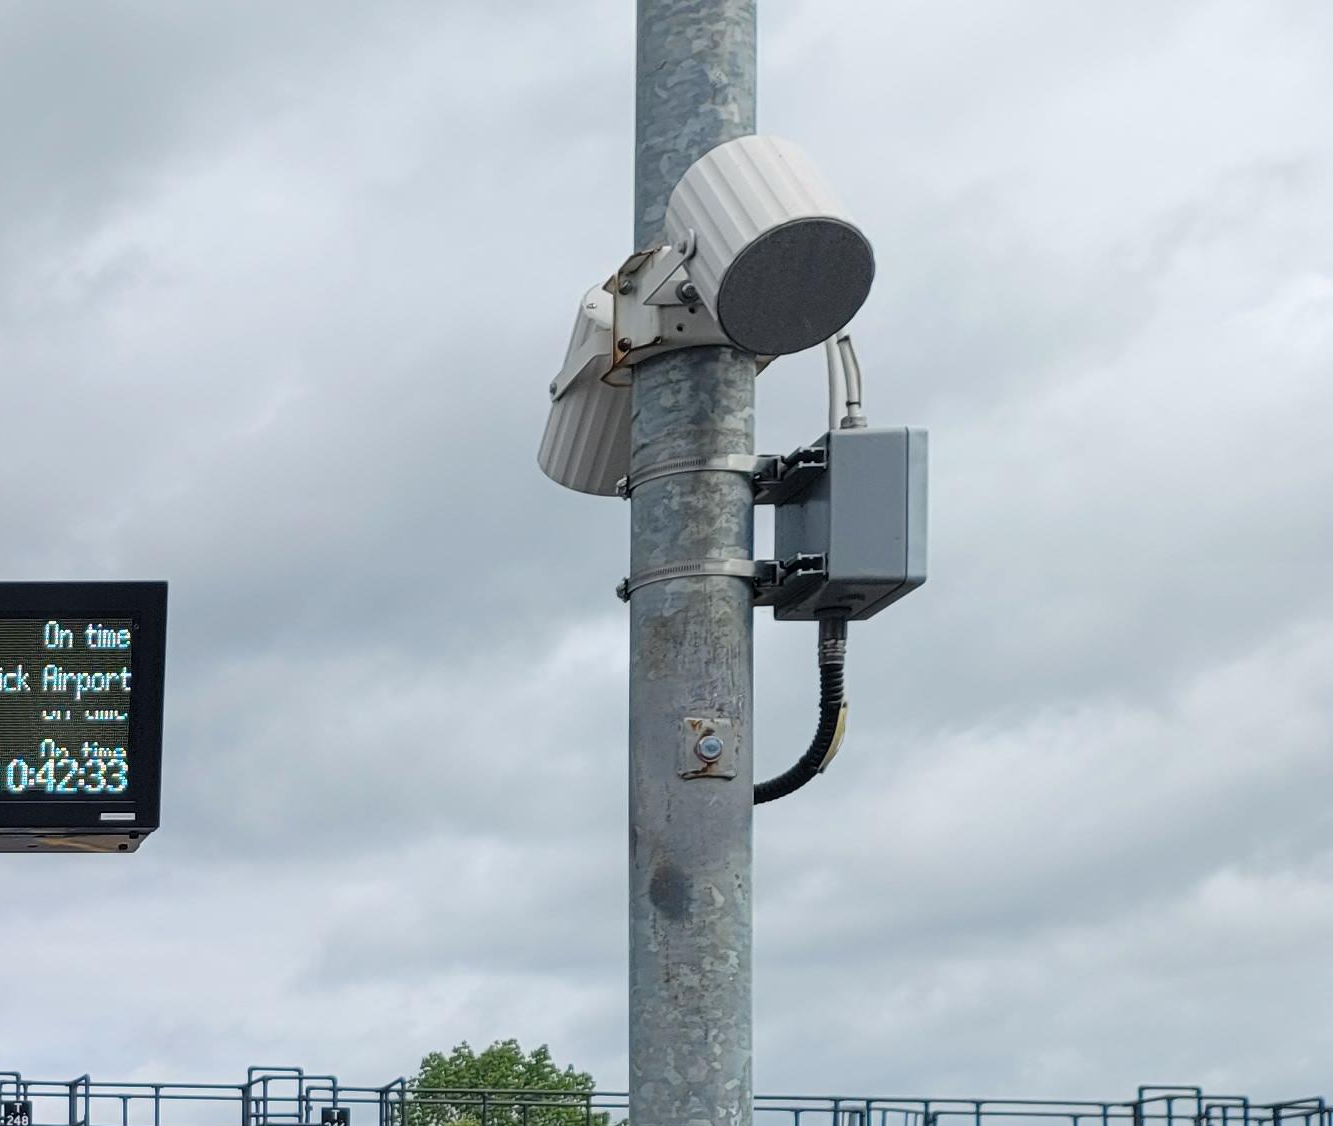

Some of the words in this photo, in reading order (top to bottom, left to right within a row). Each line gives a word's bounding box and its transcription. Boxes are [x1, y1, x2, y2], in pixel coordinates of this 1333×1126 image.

[44, 621, 73, 648] On
[85, 623, 131, 648] time
[43, 664, 131, 699] Airport
[14, 1102, 23, 1113] T
[331, 1109, 340, 1120] T
[6, 1115, 29, 1126] 248
